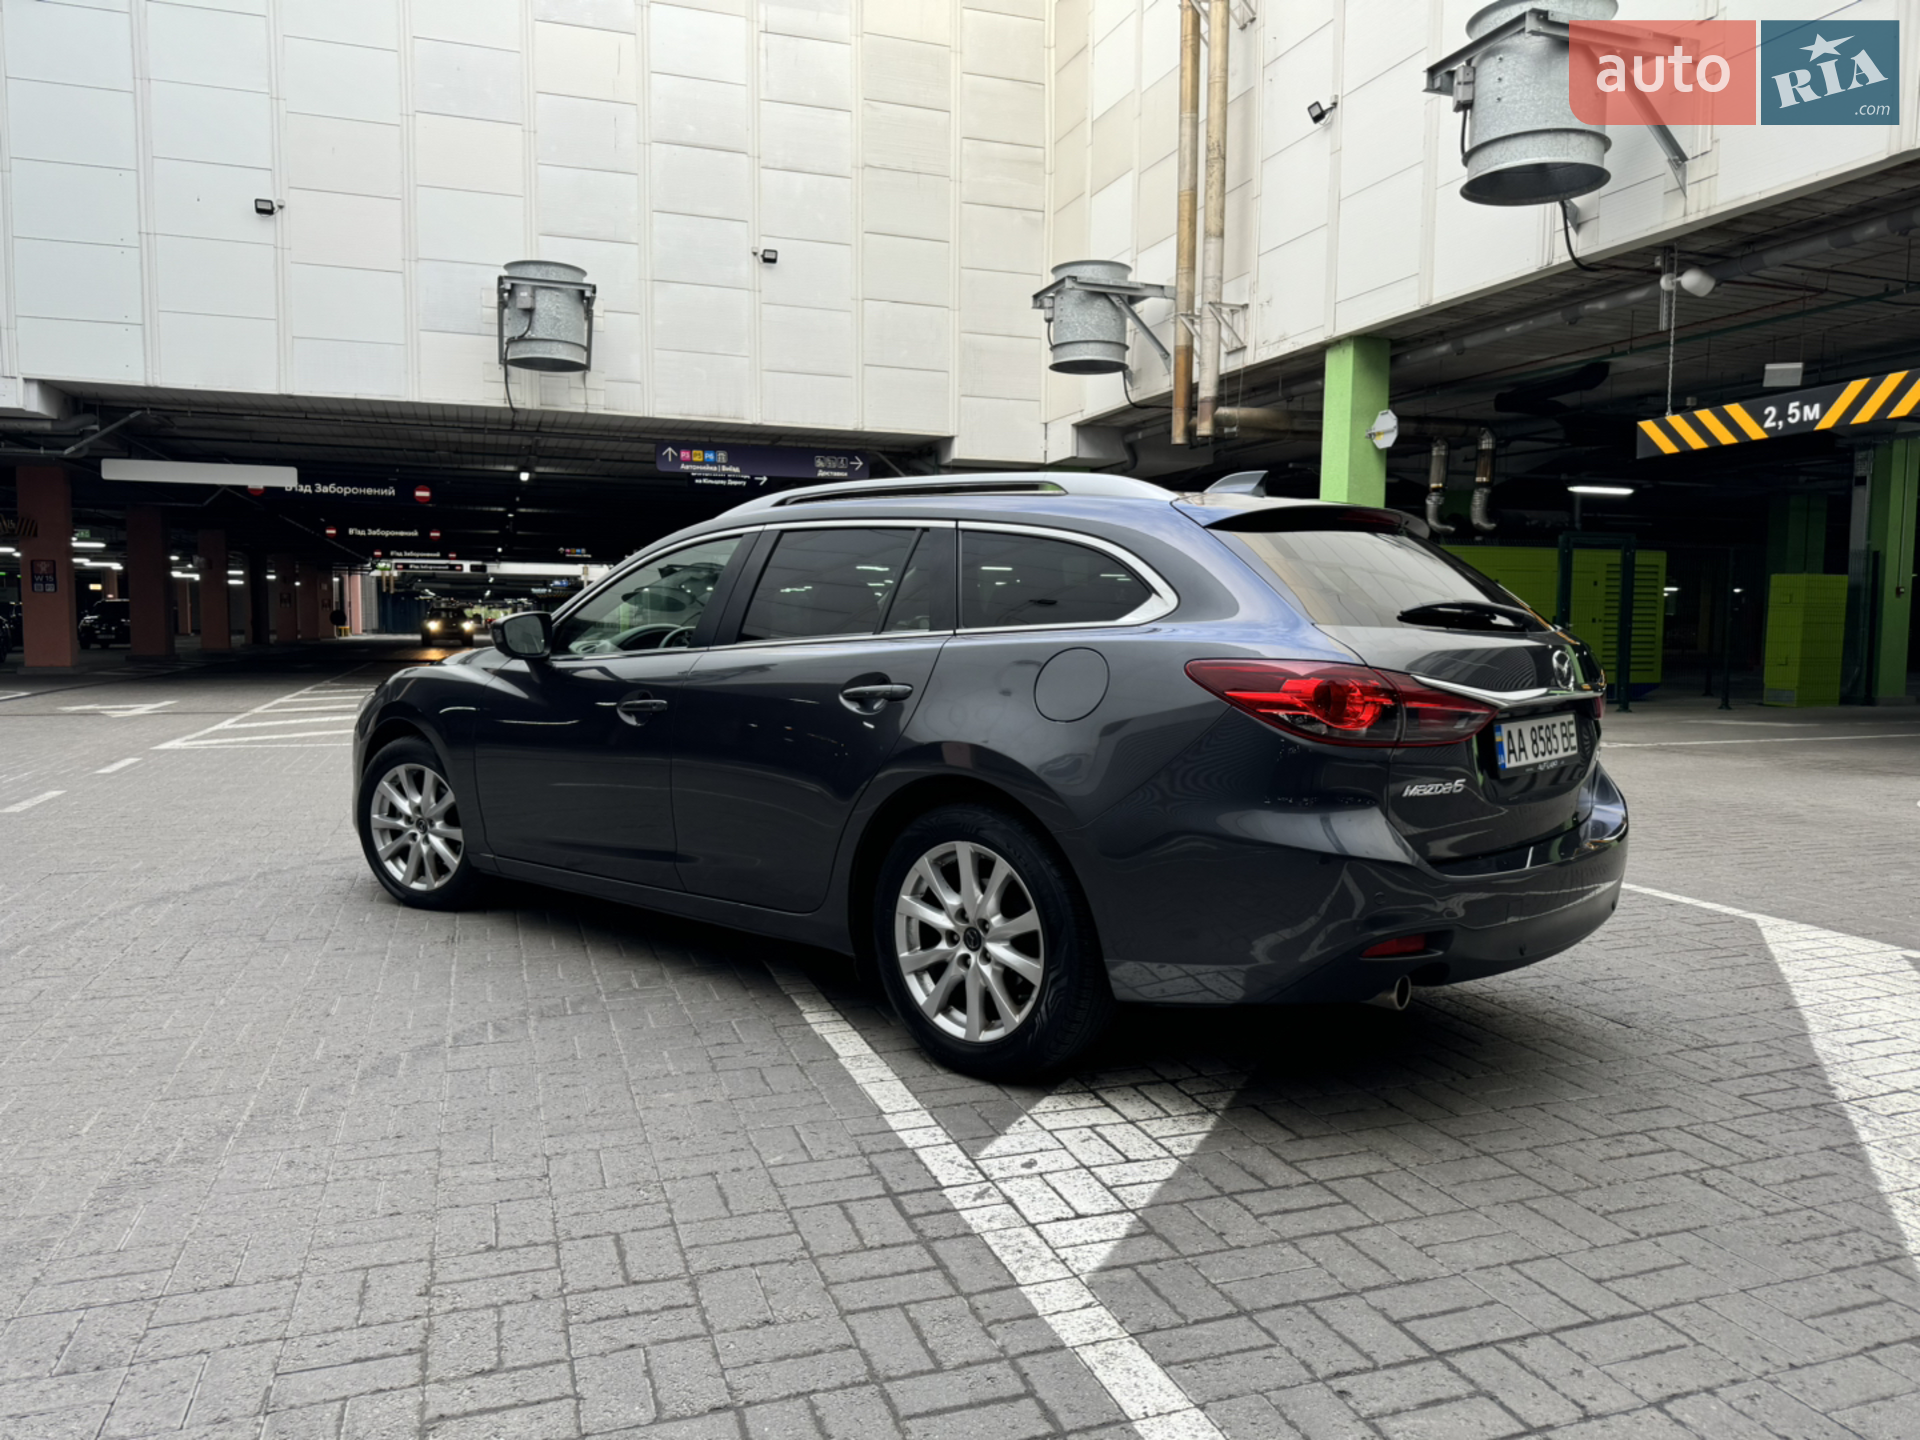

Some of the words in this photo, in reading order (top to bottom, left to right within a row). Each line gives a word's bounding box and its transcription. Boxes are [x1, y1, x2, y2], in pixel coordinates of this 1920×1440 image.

[314, 483, 396, 497] Заборонений
[1507, 729, 1528, 763] AA
[1530, 722, 1559, 759] 8585
[1560, 720, 1577, 752] BE
